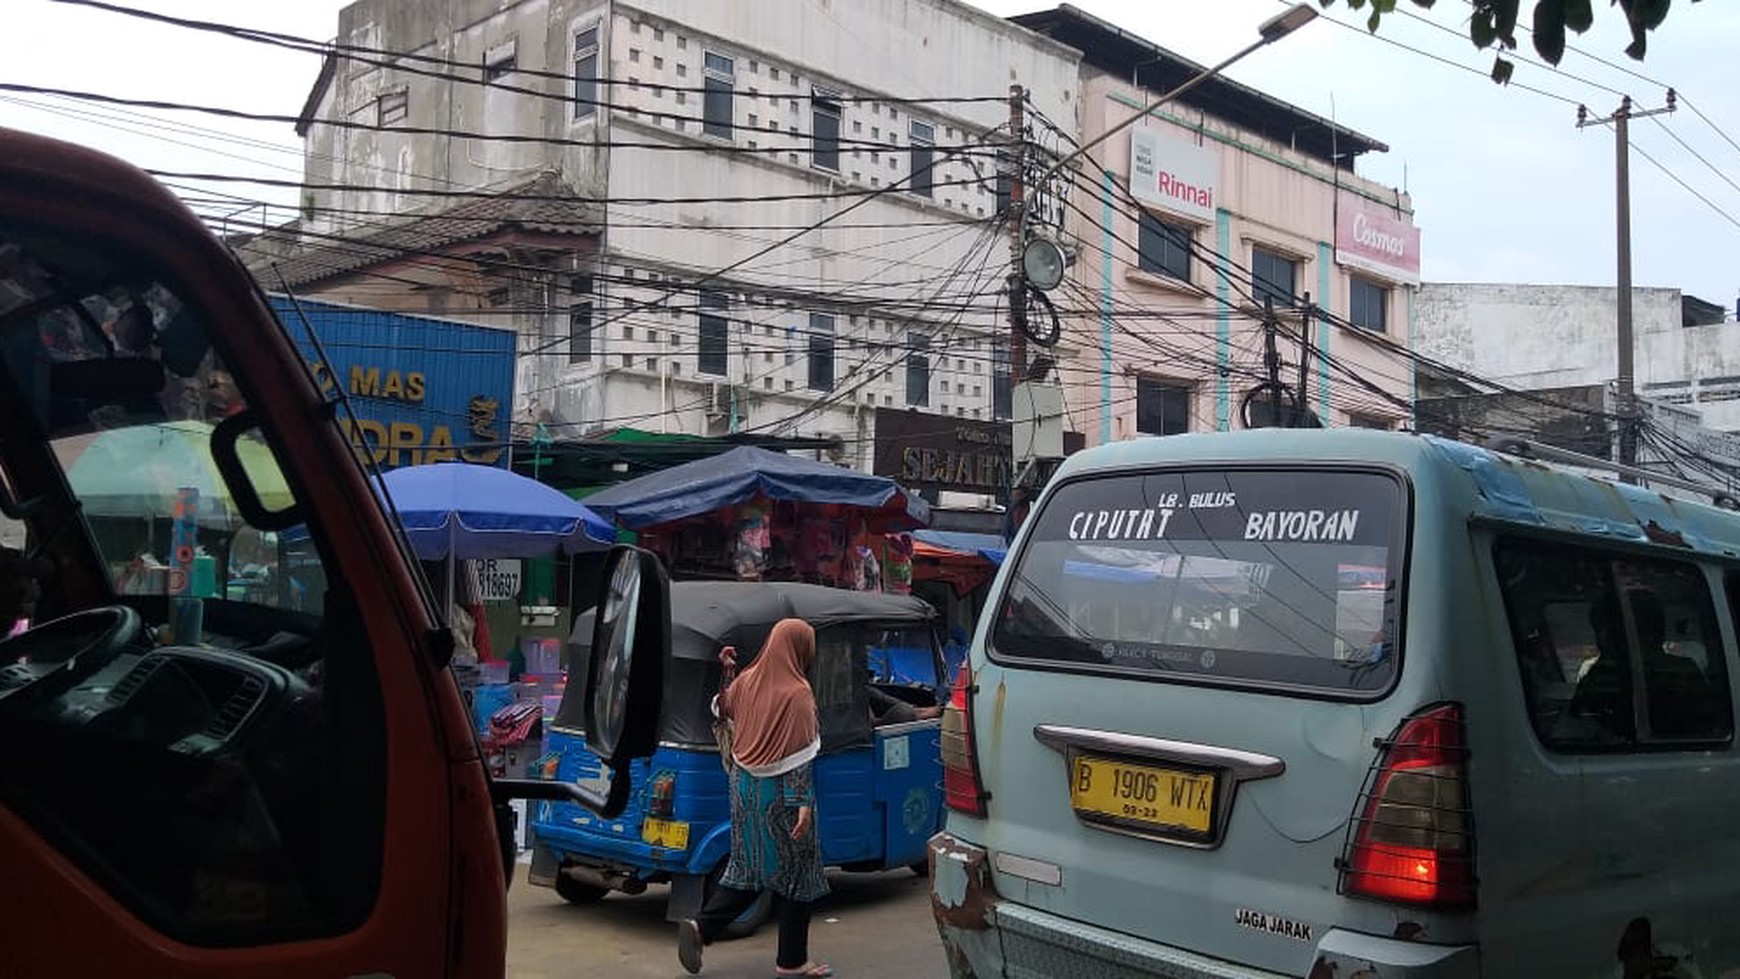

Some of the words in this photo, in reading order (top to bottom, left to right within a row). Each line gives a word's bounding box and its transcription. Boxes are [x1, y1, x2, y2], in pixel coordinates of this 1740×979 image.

[1158, 170, 1213, 209] Rinnai
[1353, 213, 1405, 258] Cosmos
[350, 364, 425, 402] MAS
[1188, 491, 1236, 509] BULUS
[1068, 508, 1173, 540] CIPUTAT
[1244, 510, 1360, 541] BAYORAN
[1078, 763, 1092, 793] B
[1112, 768, 1160, 803] 1906
[1170, 775, 1209, 812] WTX
[1235, 909, 1268, 931] JAGA
[1269, 916, 1312, 941] JARAK
